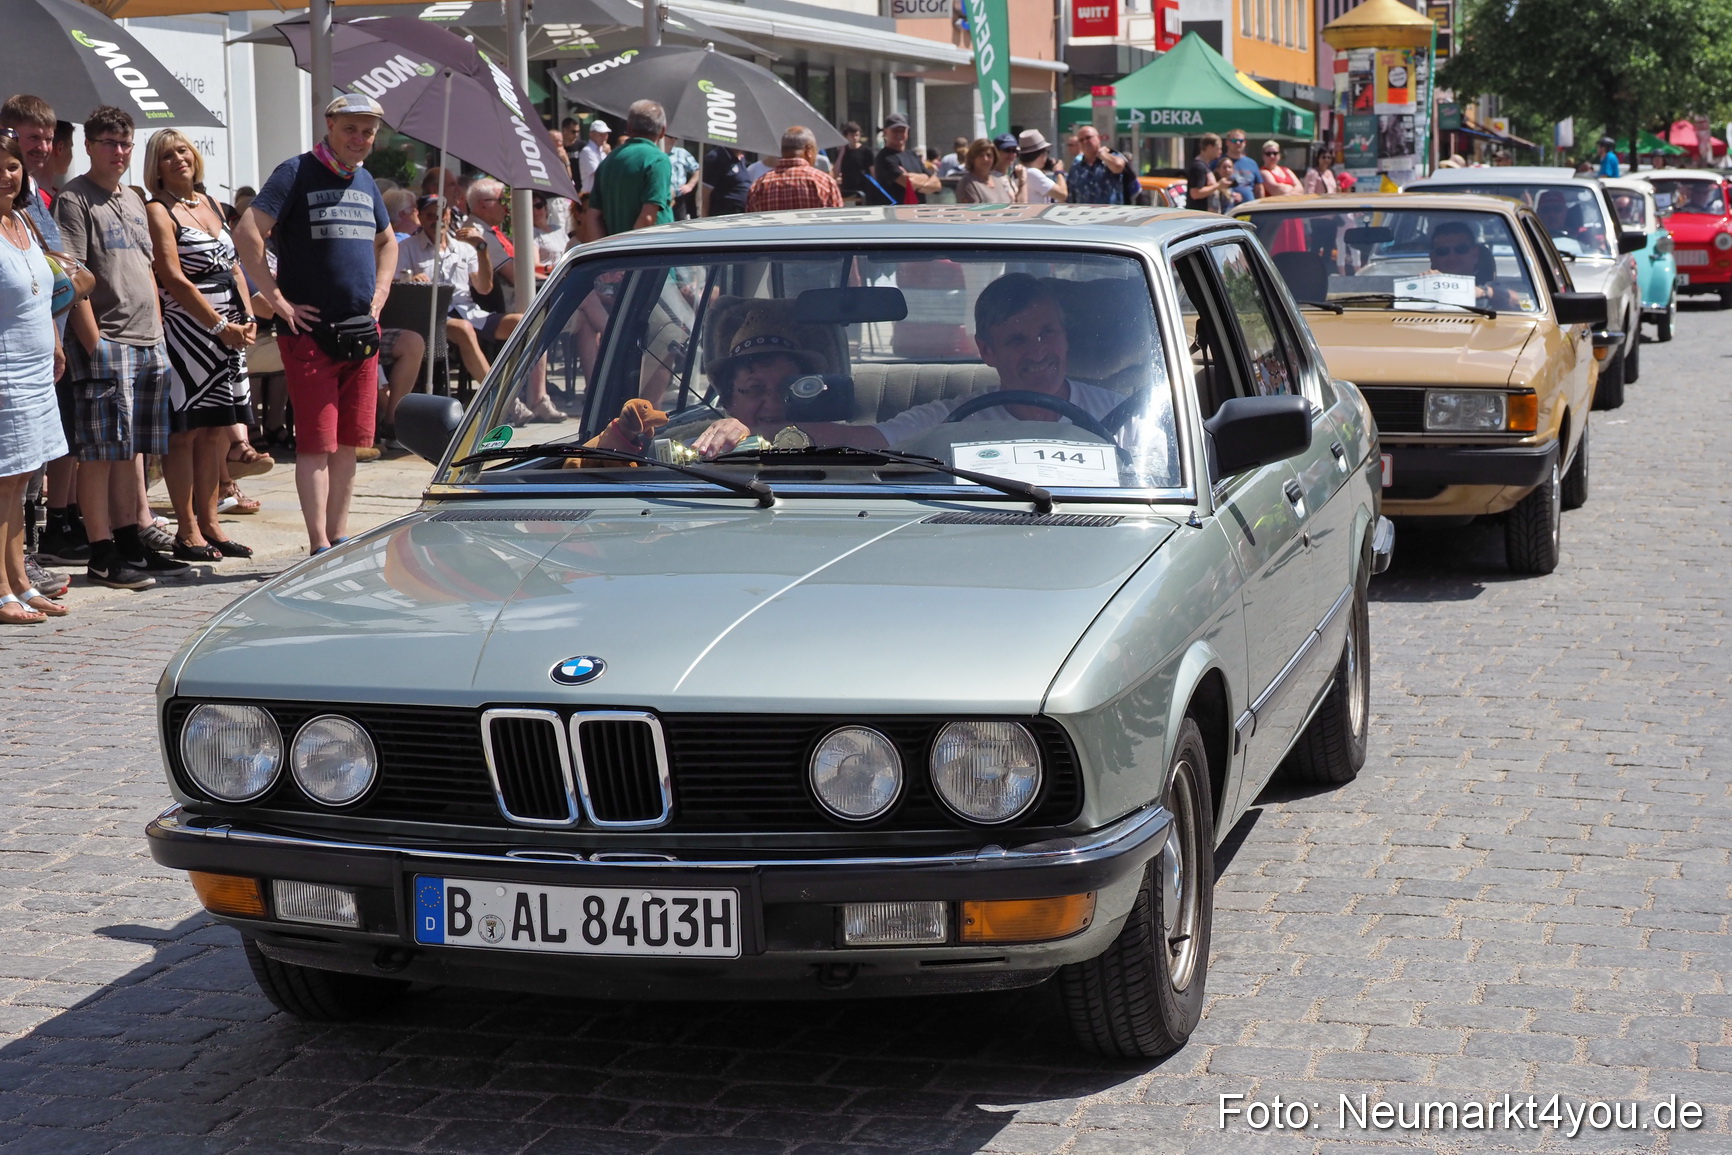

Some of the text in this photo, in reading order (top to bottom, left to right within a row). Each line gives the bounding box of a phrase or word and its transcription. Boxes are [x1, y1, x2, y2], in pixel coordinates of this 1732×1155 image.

[1077, 6, 1110, 19] WITT
[568, 54, 633, 83] now
[705, 84, 738, 138] now
[1150, 110, 1204, 126] DEKRA
[318, 208, 363, 219] DENIM
[1432, 280, 1460, 291] 398
[1033, 449, 1087, 465] 144
[425, 886, 732, 948] D B AL 8403H
